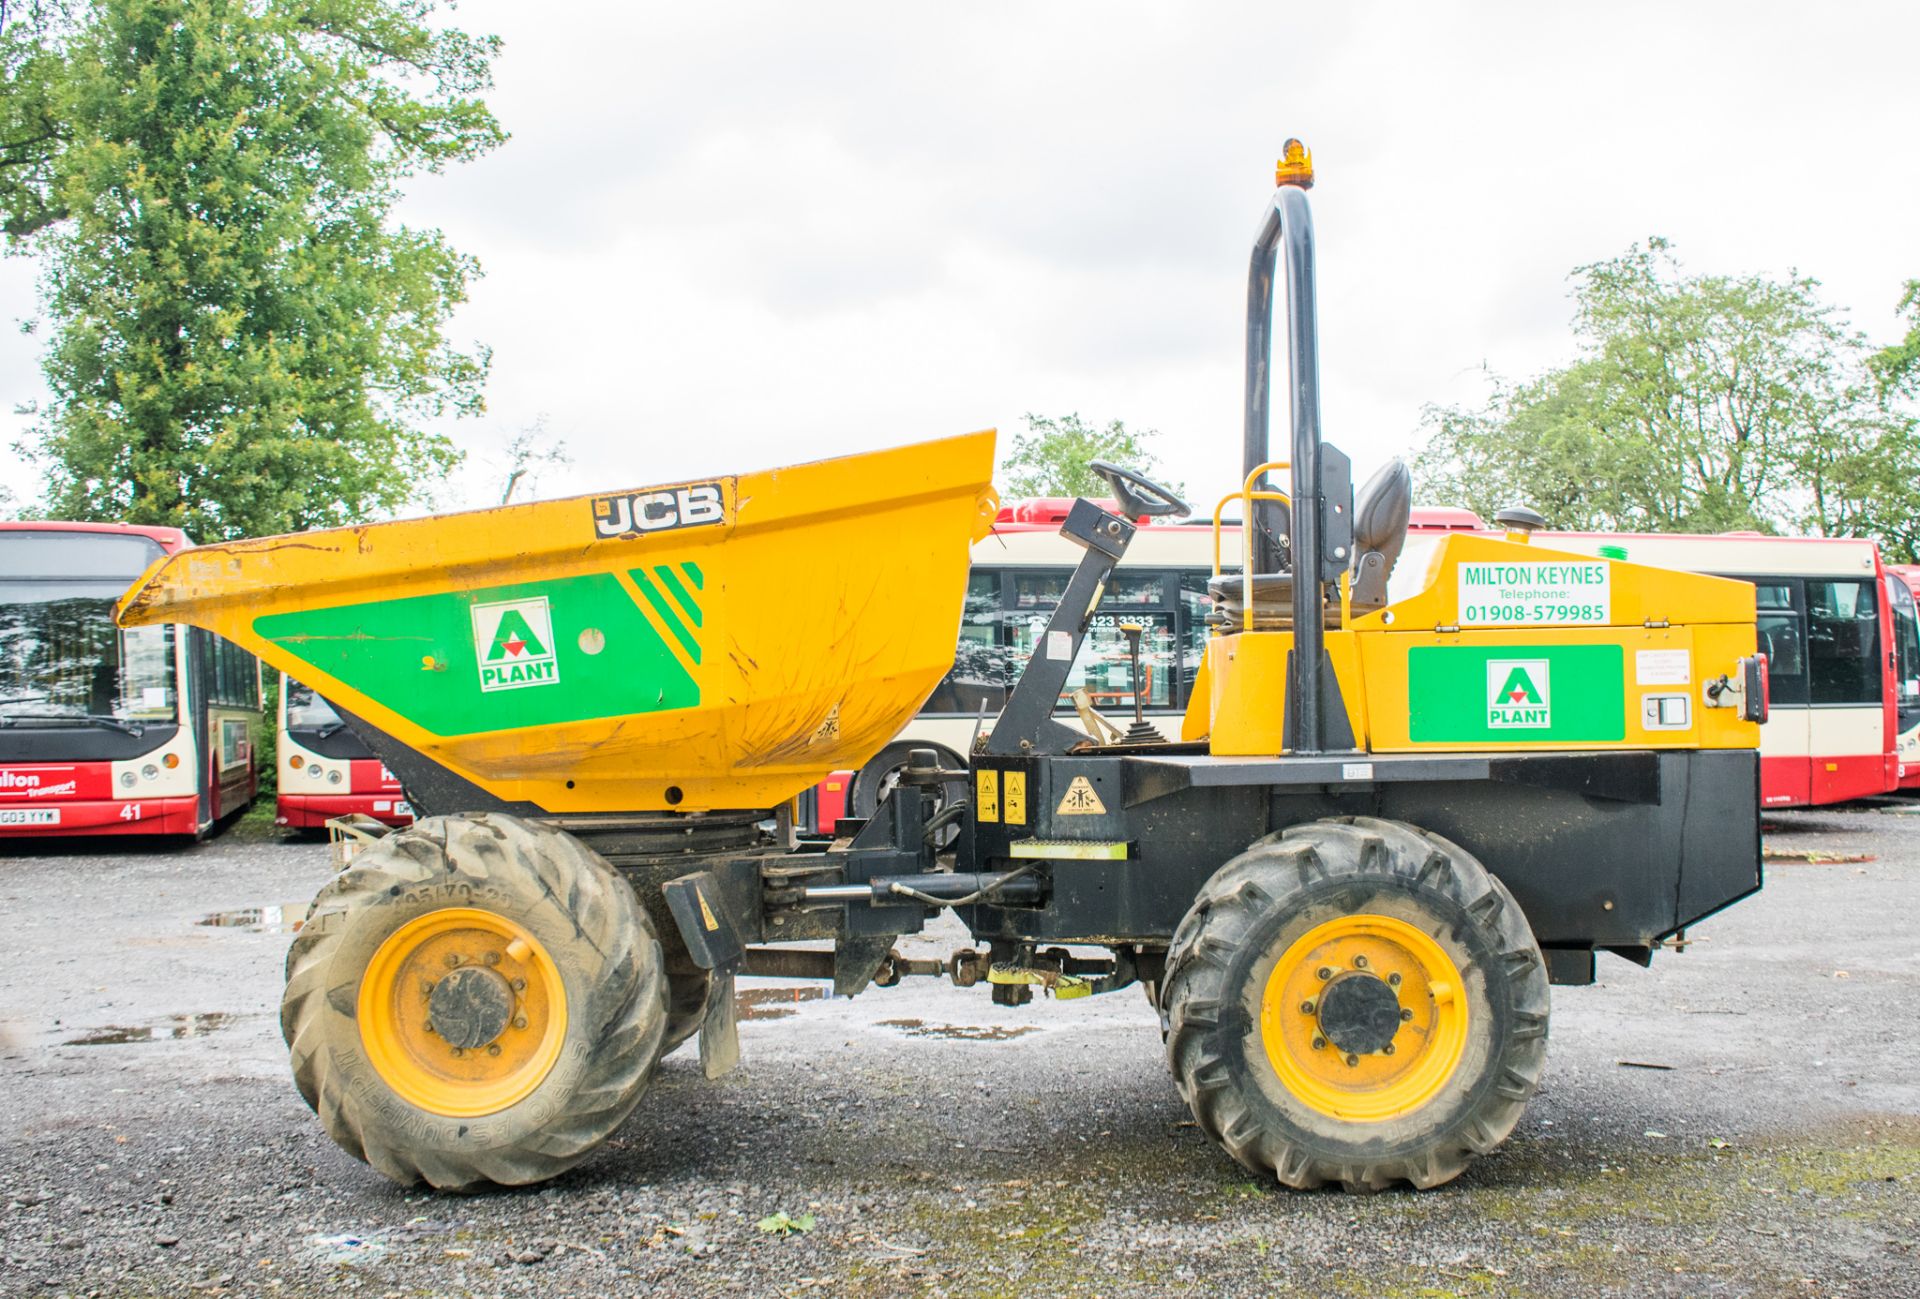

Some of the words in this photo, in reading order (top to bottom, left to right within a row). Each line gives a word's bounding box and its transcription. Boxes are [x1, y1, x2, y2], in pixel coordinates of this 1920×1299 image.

[596, 487, 723, 535] JCB
[1465, 567, 1531, 585] MILTON
[1537, 566, 1604, 585] KEYNES
[1499, 589, 1570, 601] Telephone:
[1090, 615, 1115, 627] 423
[1466, 605, 1604, 621] 01908-579985
[482, 661, 554, 686] PLANT
[1490, 710, 1547, 723] PLANT
[0, 770, 40, 788] lton
[120, 804, 141, 820] 41
